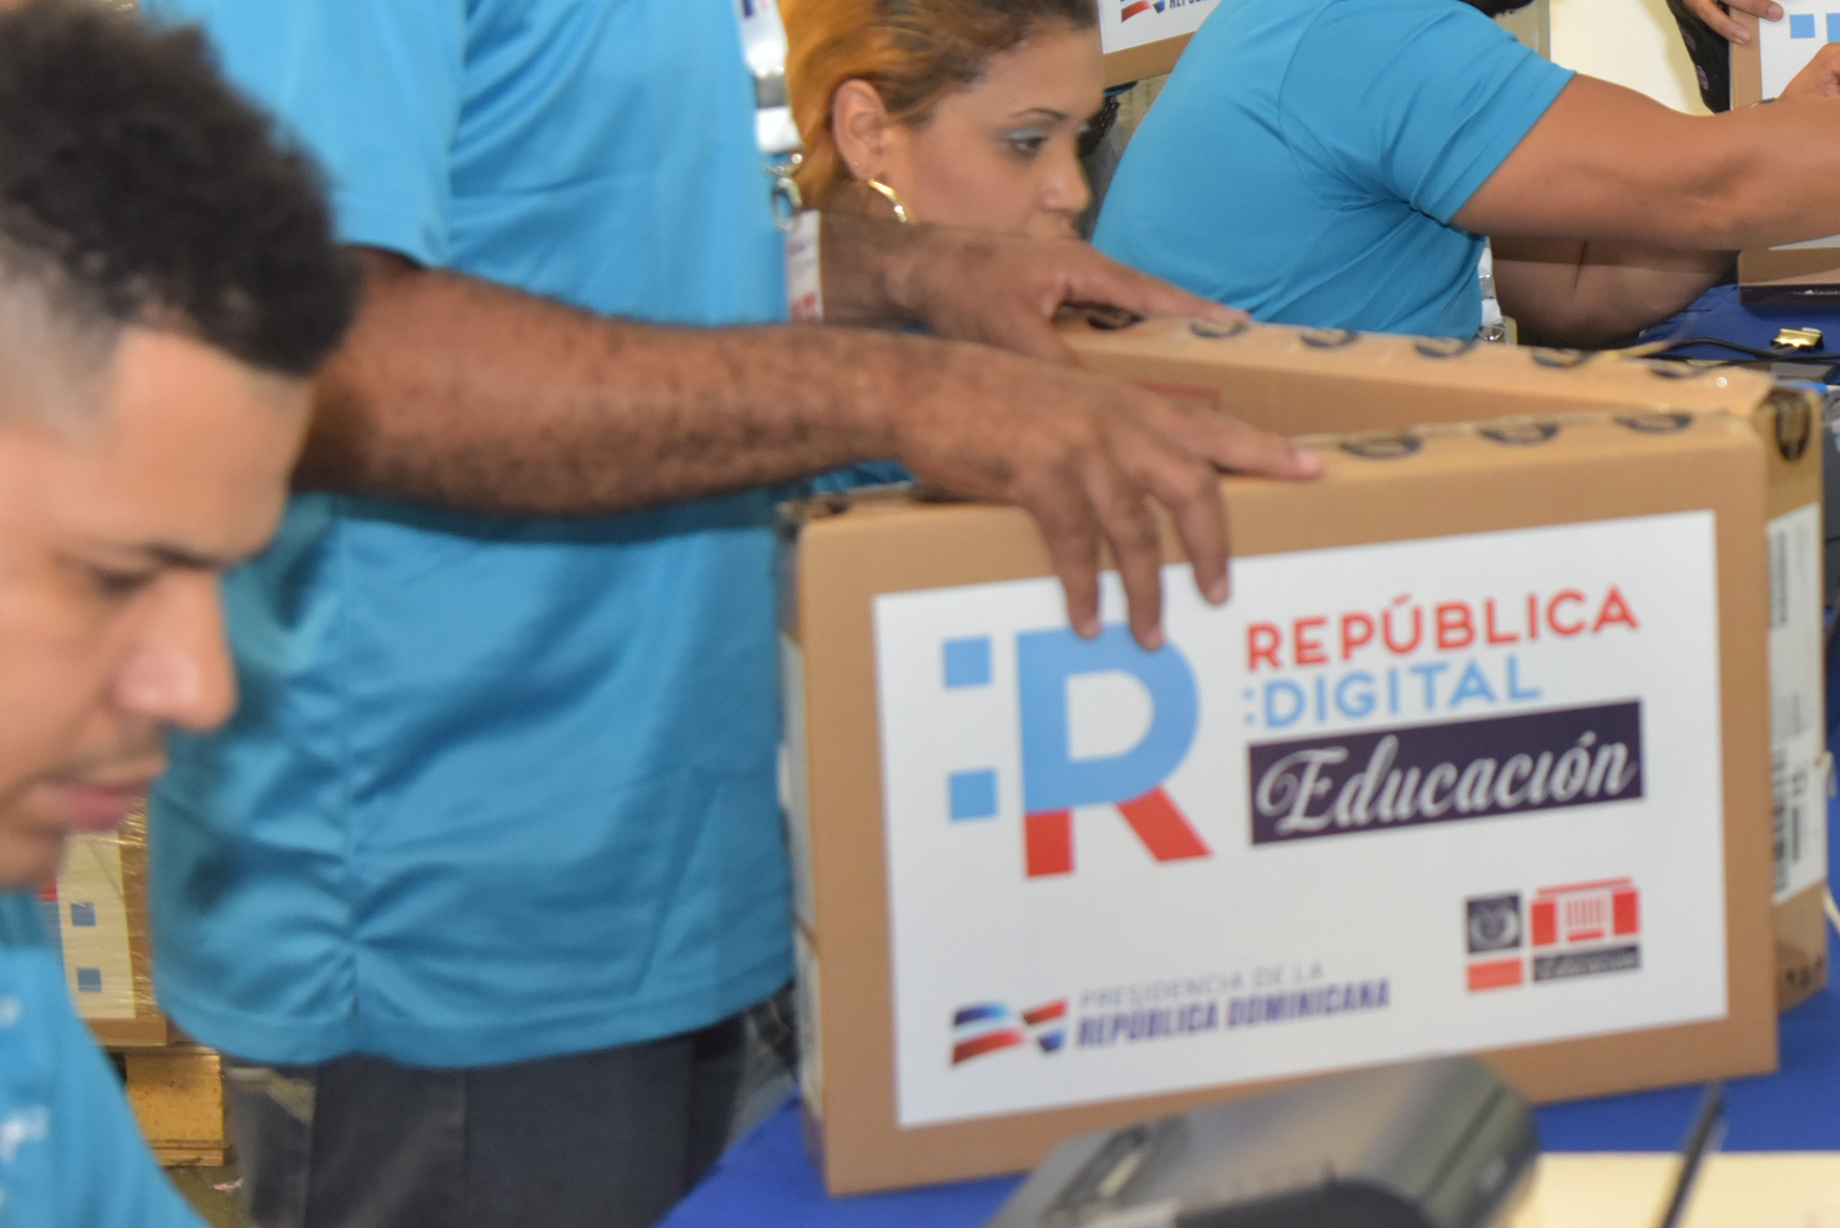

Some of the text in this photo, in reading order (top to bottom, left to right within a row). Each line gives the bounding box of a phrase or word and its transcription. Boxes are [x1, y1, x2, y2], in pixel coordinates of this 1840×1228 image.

[1245, 583, 1642, 672] REPÚBLICA
[1255, 729, 1640, 837] Educación
[1077, 977, 1390, 1049] REPÚBLICA DOMINICANA
[1080, 960, 1325, 1008] PRESIDENCIA DE LA
